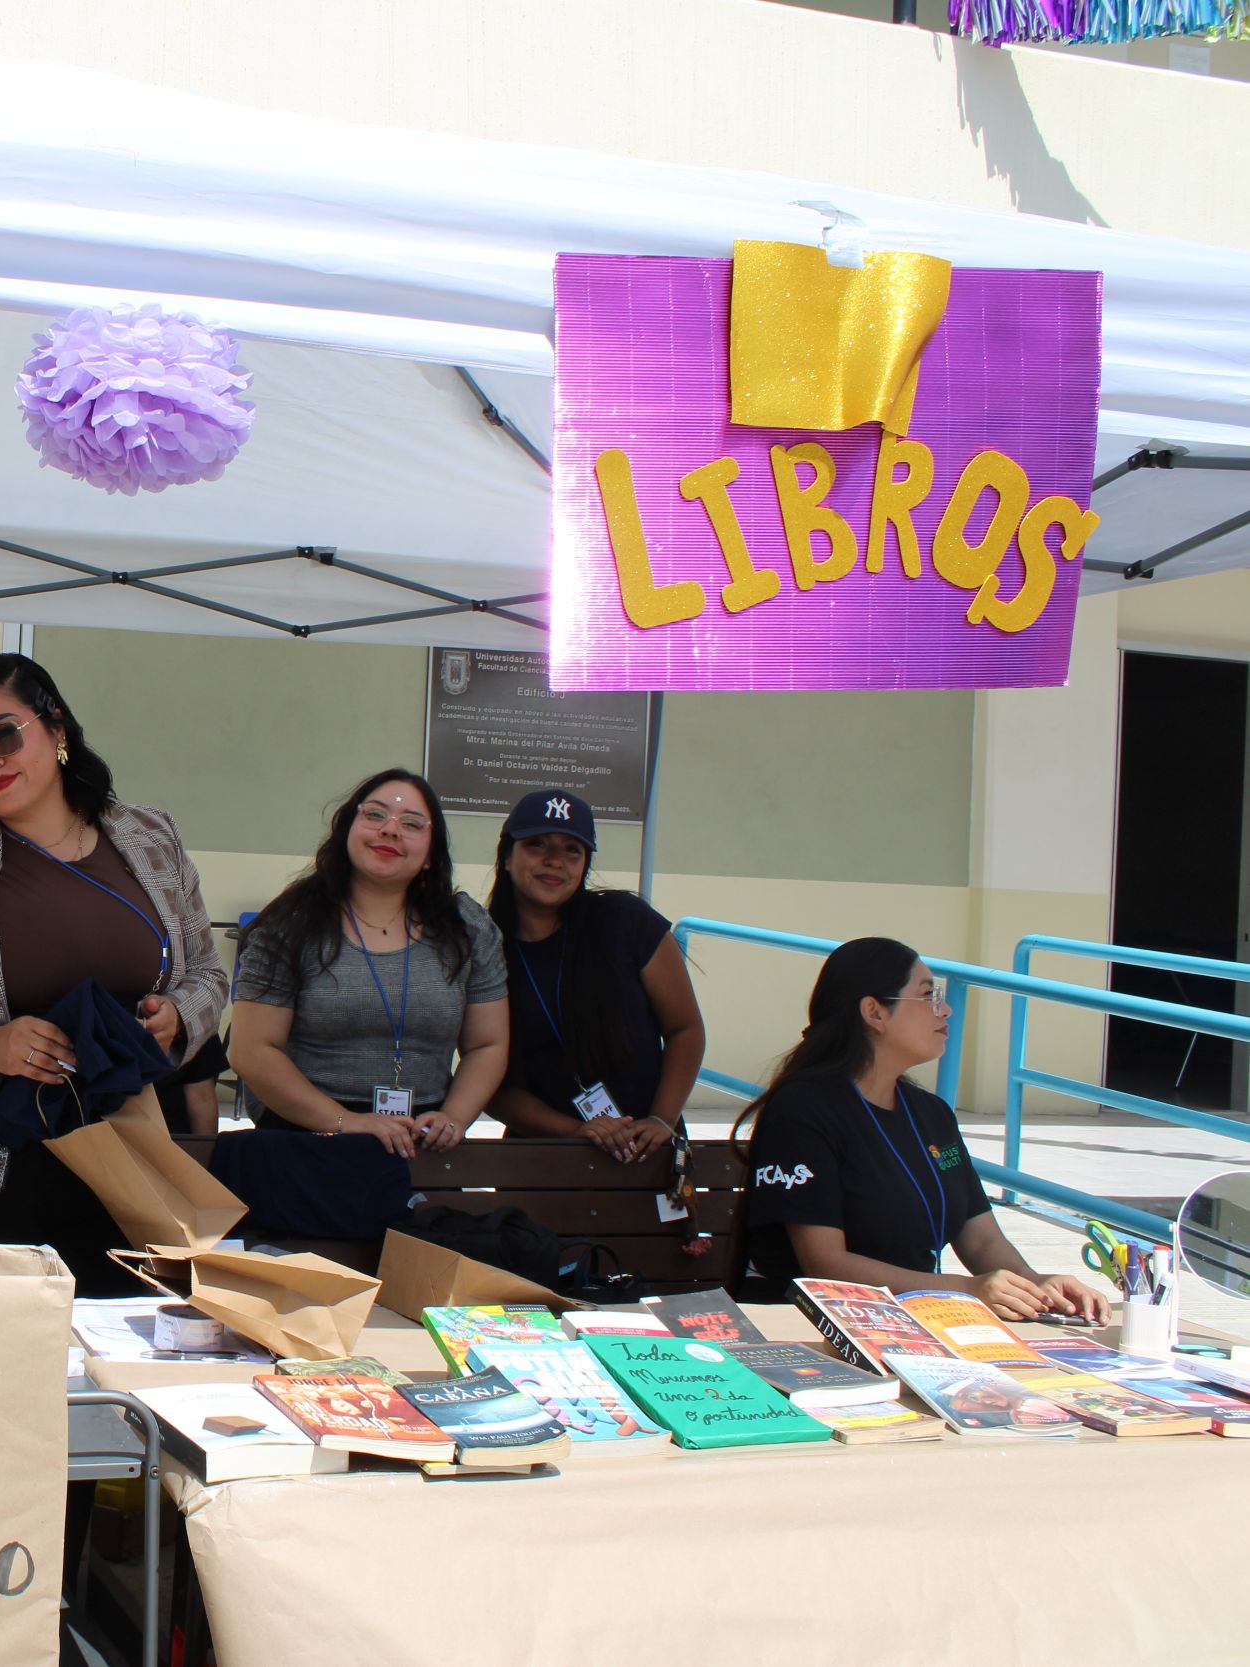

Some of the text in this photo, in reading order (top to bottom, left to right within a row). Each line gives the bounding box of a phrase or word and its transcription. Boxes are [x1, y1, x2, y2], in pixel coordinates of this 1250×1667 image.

[595, 433, 1101, 633] LIBROS
[475, 652, 524, 663] Universidad
[478, 662, 508, 672] Facultad
[509, 664, 518, 672] de
[517, 687, 556, 699] Edificio
[441, 703, 476, 712] Construido
[483, 707, 512, 715] equipado
[466, 735, 488, 744] Mtra.
[490, 737, 518, 747] Marina
[521, 739, 534, 747] del
[536, 740, 555, 749] Pilar
[580, 743, 610, 752] Olmeda
[463, 757, 612, 775] Dr. Daniel Octavio Valdez Delgadillo
[509, 778, 544, 786] realización
[440, 796, 468, 804] Ensenada,
[544, 797, 571, 820] NY
[756, 1164, 812, 1190] FCAyS
[678, 1313, 734, 1328] NOTE
[833, 1306, 912, 1323] IDEAS
[817, 1316, 860, 1365] IDEAS
[611, 1342, 686, 1361] Todos
[287, 1377, 330, 1386] JORGE
[415, 1385, 510, 1402] CABAÑA
[442, 1386, 467, 1394] LA
[654, 1391, 704, 1402] una
[307, 1412, 391, 1430] VERDAD
[490, 1432, 512, 1440] PAUL
[512, 1427, 546, 1438] YOUNG
